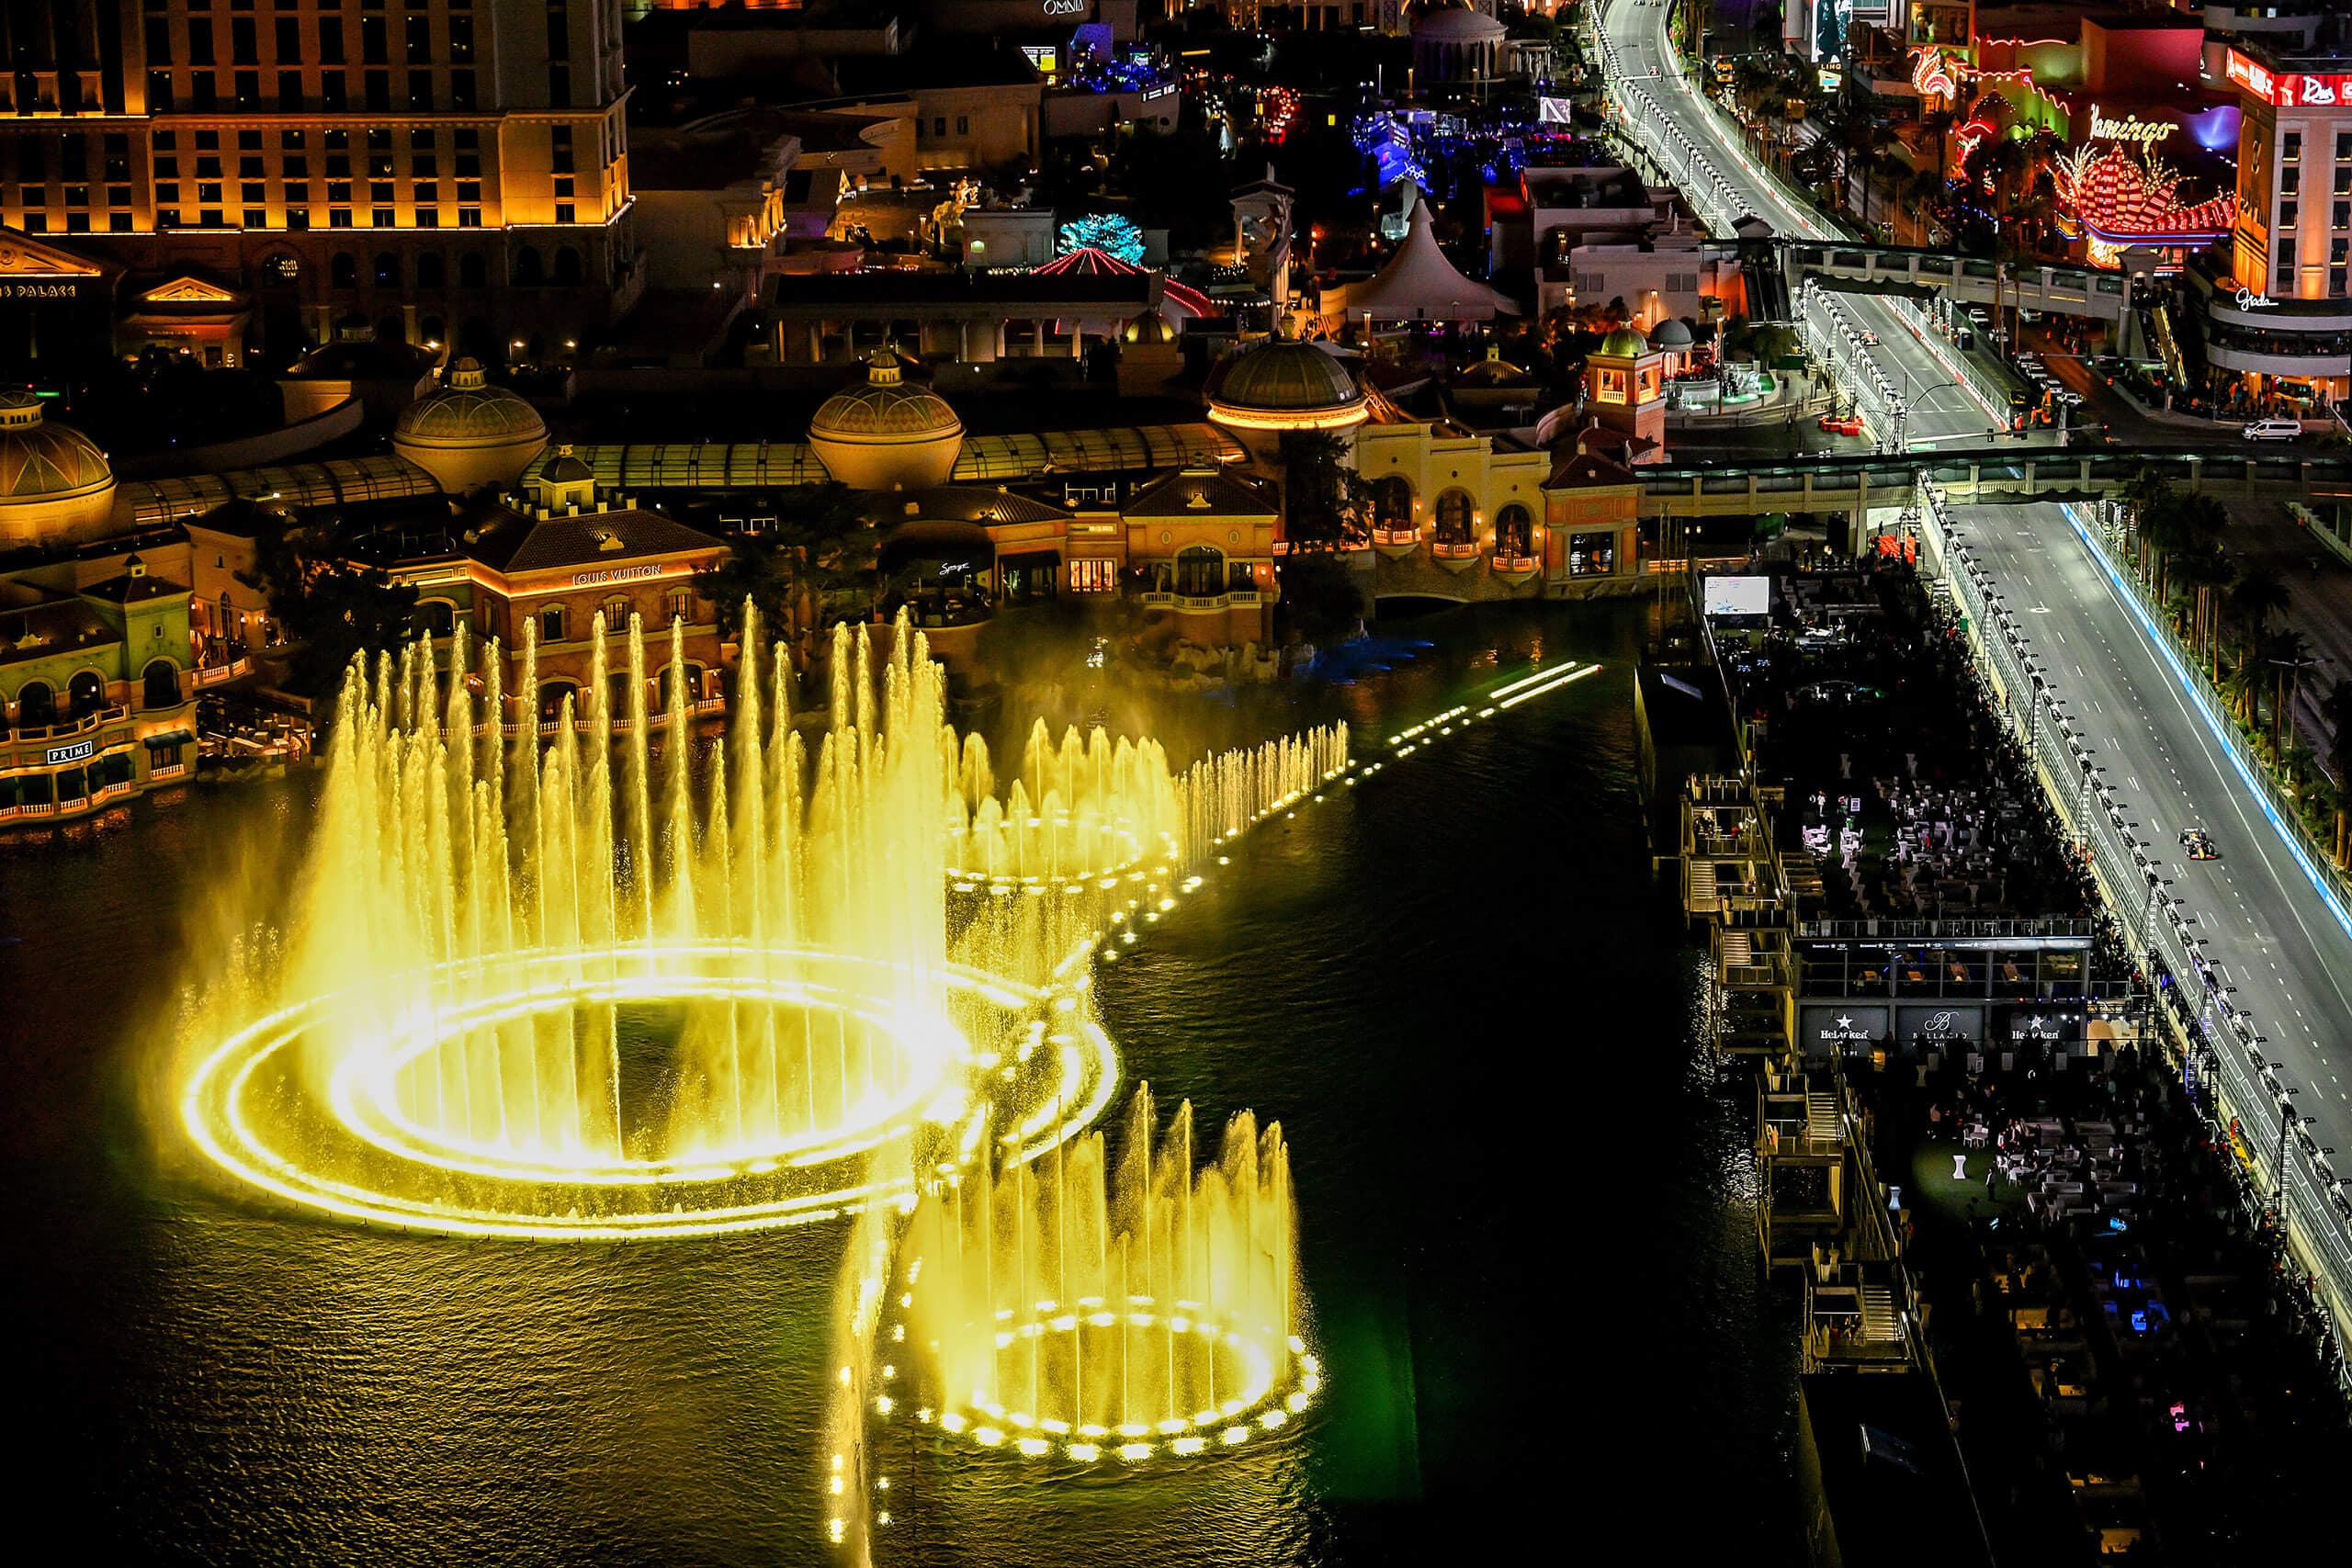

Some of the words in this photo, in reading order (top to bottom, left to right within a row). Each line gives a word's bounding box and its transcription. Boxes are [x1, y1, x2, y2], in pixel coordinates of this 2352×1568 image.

[1043, 0, 1084, 16] OMNIA
[17, 285, 75, 298] PALACE
[572, 570, 609, 586] LOUIS
[610, 564, 662, 581] VUITTON
[51, 744, 90, 761] PRIME
[1912, 1032, 1968, 1040] BLLAIO
[2012, 1030, 2060, 1040] Heken
